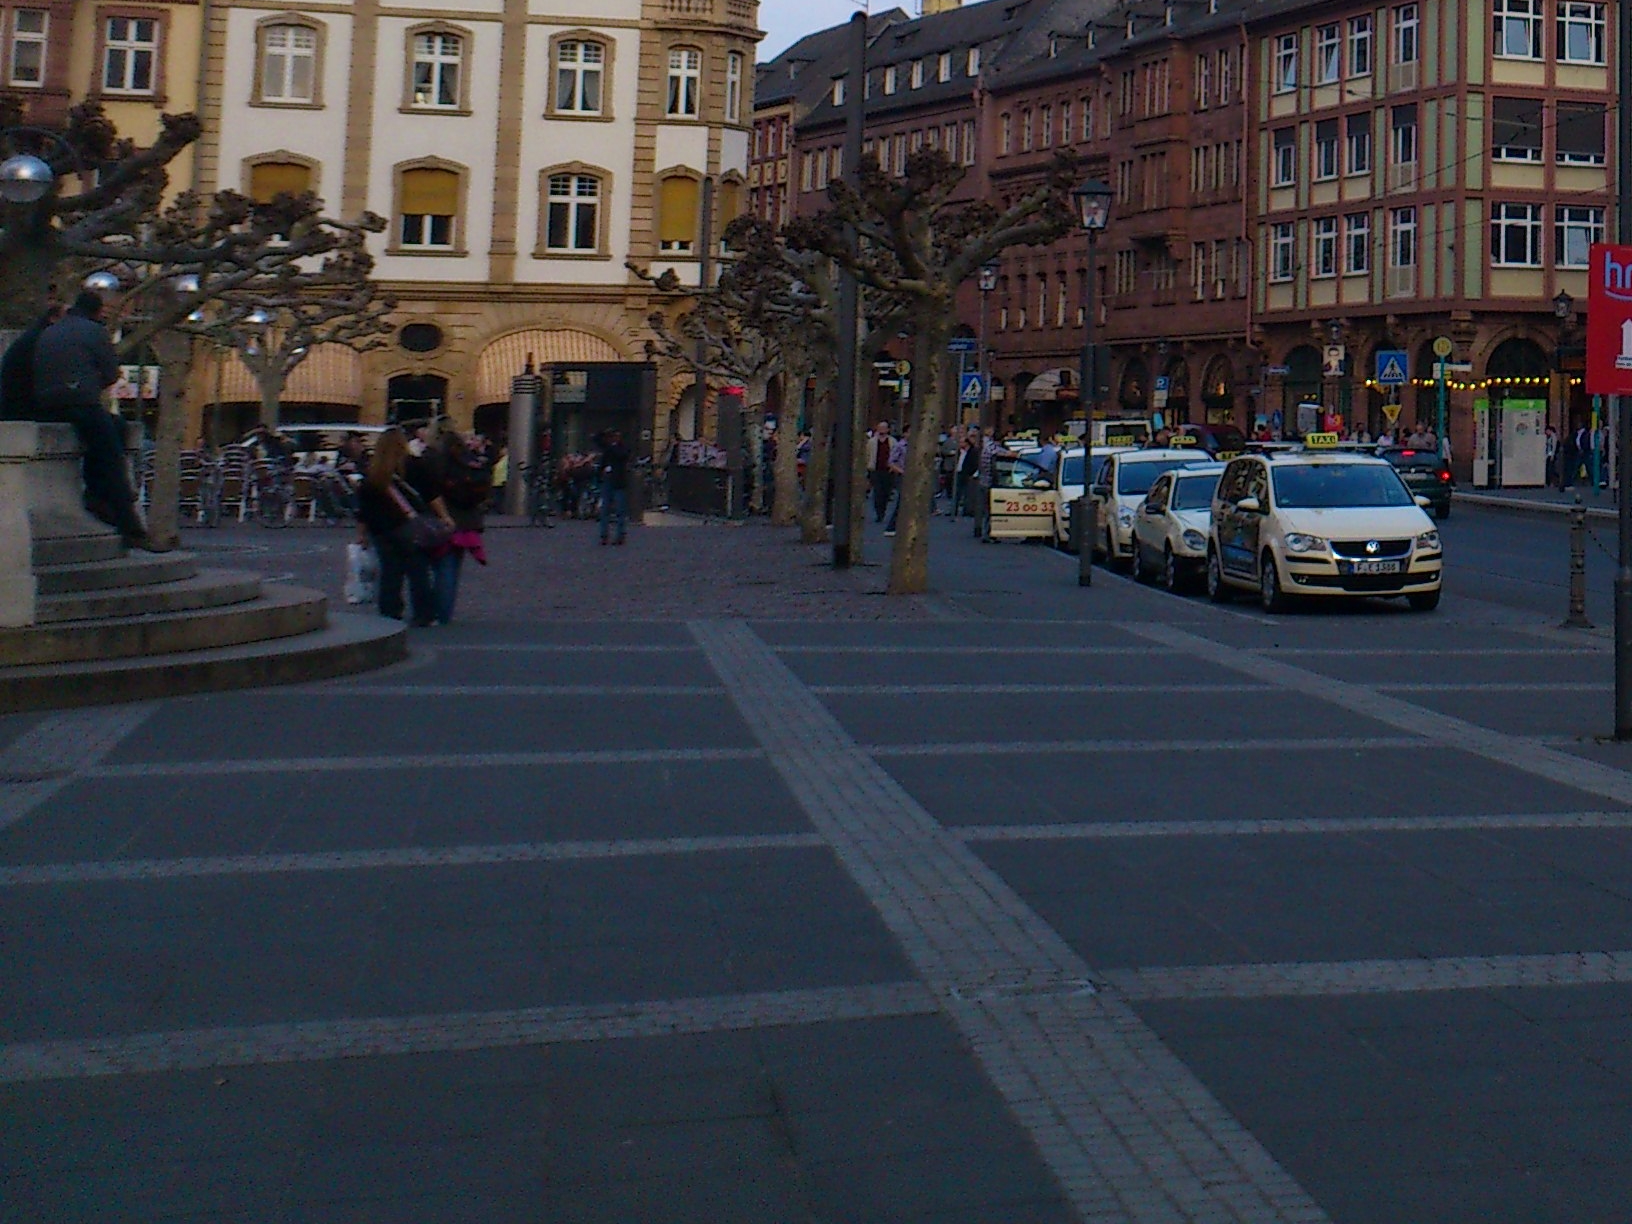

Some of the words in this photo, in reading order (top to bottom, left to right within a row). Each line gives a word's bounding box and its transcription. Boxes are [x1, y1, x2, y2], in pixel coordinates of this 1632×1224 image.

[1311, 435, 1336, 445] TAXI
[1006, 501, 1020, 512] 23
[1041, 501, 1055, 512] 33
